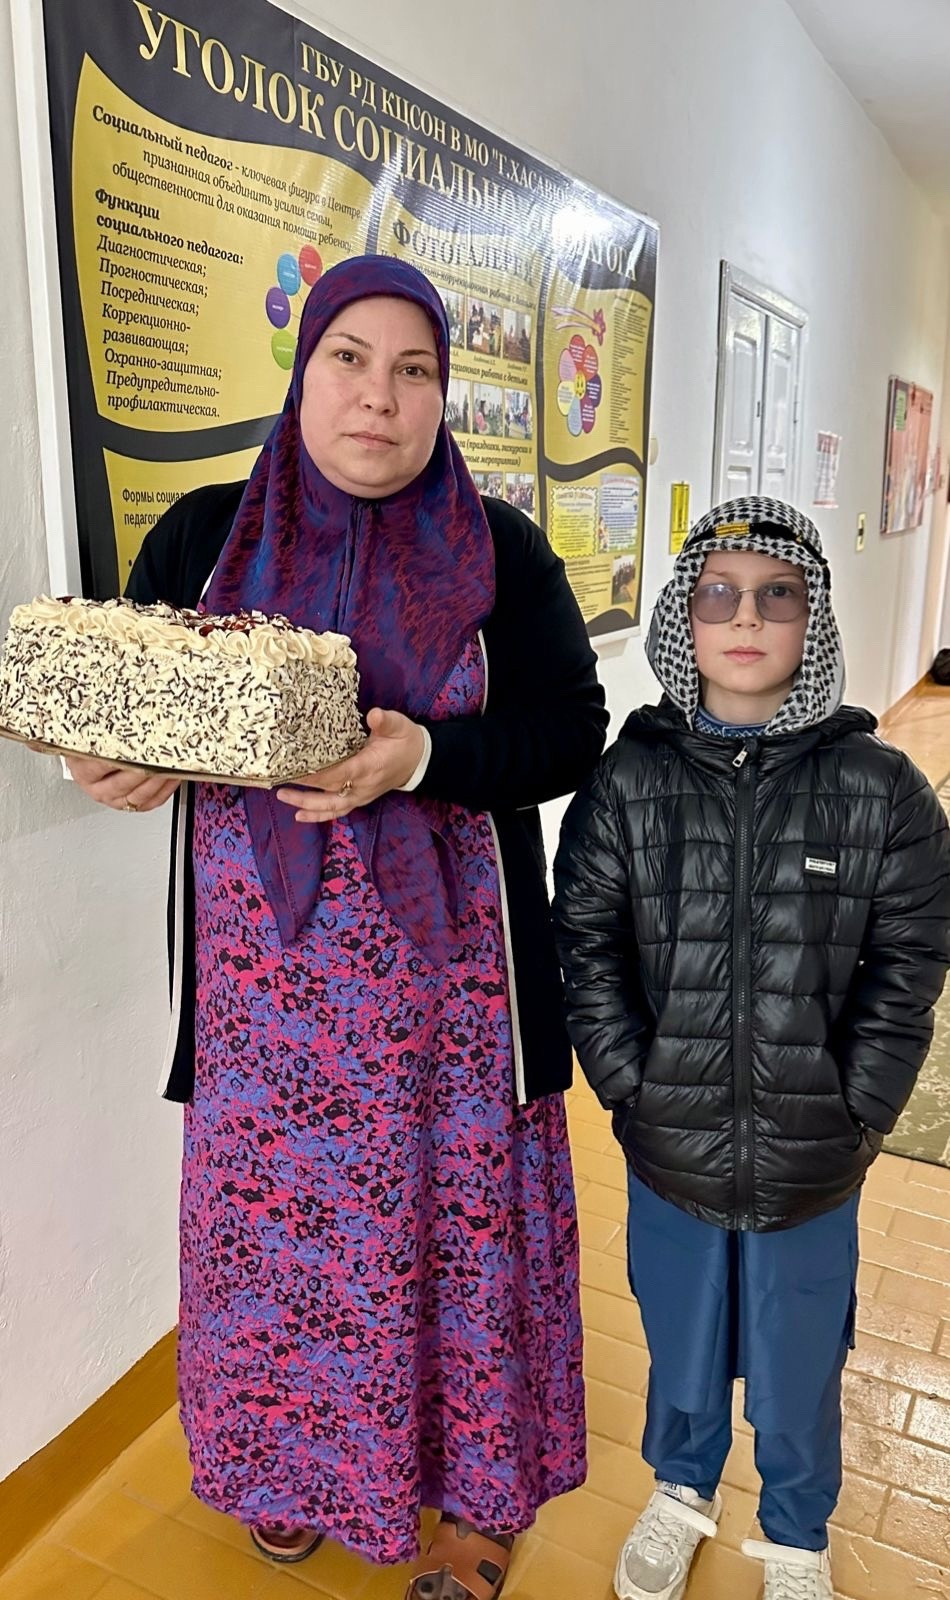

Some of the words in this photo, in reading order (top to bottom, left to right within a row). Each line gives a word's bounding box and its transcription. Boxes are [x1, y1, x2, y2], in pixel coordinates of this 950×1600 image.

[132, 0, 327, 140] УГОЛОК
[301, 42, 344, 87] ГБУ
[349, 68, 377, 113] РД
[381, 87, 446, 145] КЦСОН
[451, 126, 461, 151] В
[464, 134, 489, 167] МО
[93, 105, 183, 153] Социальный
[186, 144, 233, 171] педагог
[242, 166, 286, 190] ключевая
[289, 182, 320, 203] фигура
[321, 197, 327, 207] в
[113, 162, 215, 207] общественности
[216, 194, 235, 214] для
[237, 206, 281, 229] оказания
[283, 221, 317, 242] помощи
[143, 150, 211, 185] признанная
[213, 175, 272, 207] объединить
[274, 198, 305, 217] усилия
[95, 188, 160, 220] Функции
[97, 214, 184, 248] социального
[187, 240, 244, 265] педагога:
[97, 234, 207, 278] Диагностическая;
[99, 257, 208, 298] Прогностическая;
[101, 280, 199, 317] Посредническая;
[102, 303, 191, 333] Коррекционно-
[103, 329, 189, 355] развивающая;
[105, 348, 222, 380] Охранно-защитная;
[106, 370, 220, 397] Предупредительно-
[107, 394, 220, 418] профилактическая.
[122, 488, 154, 507] Формы
